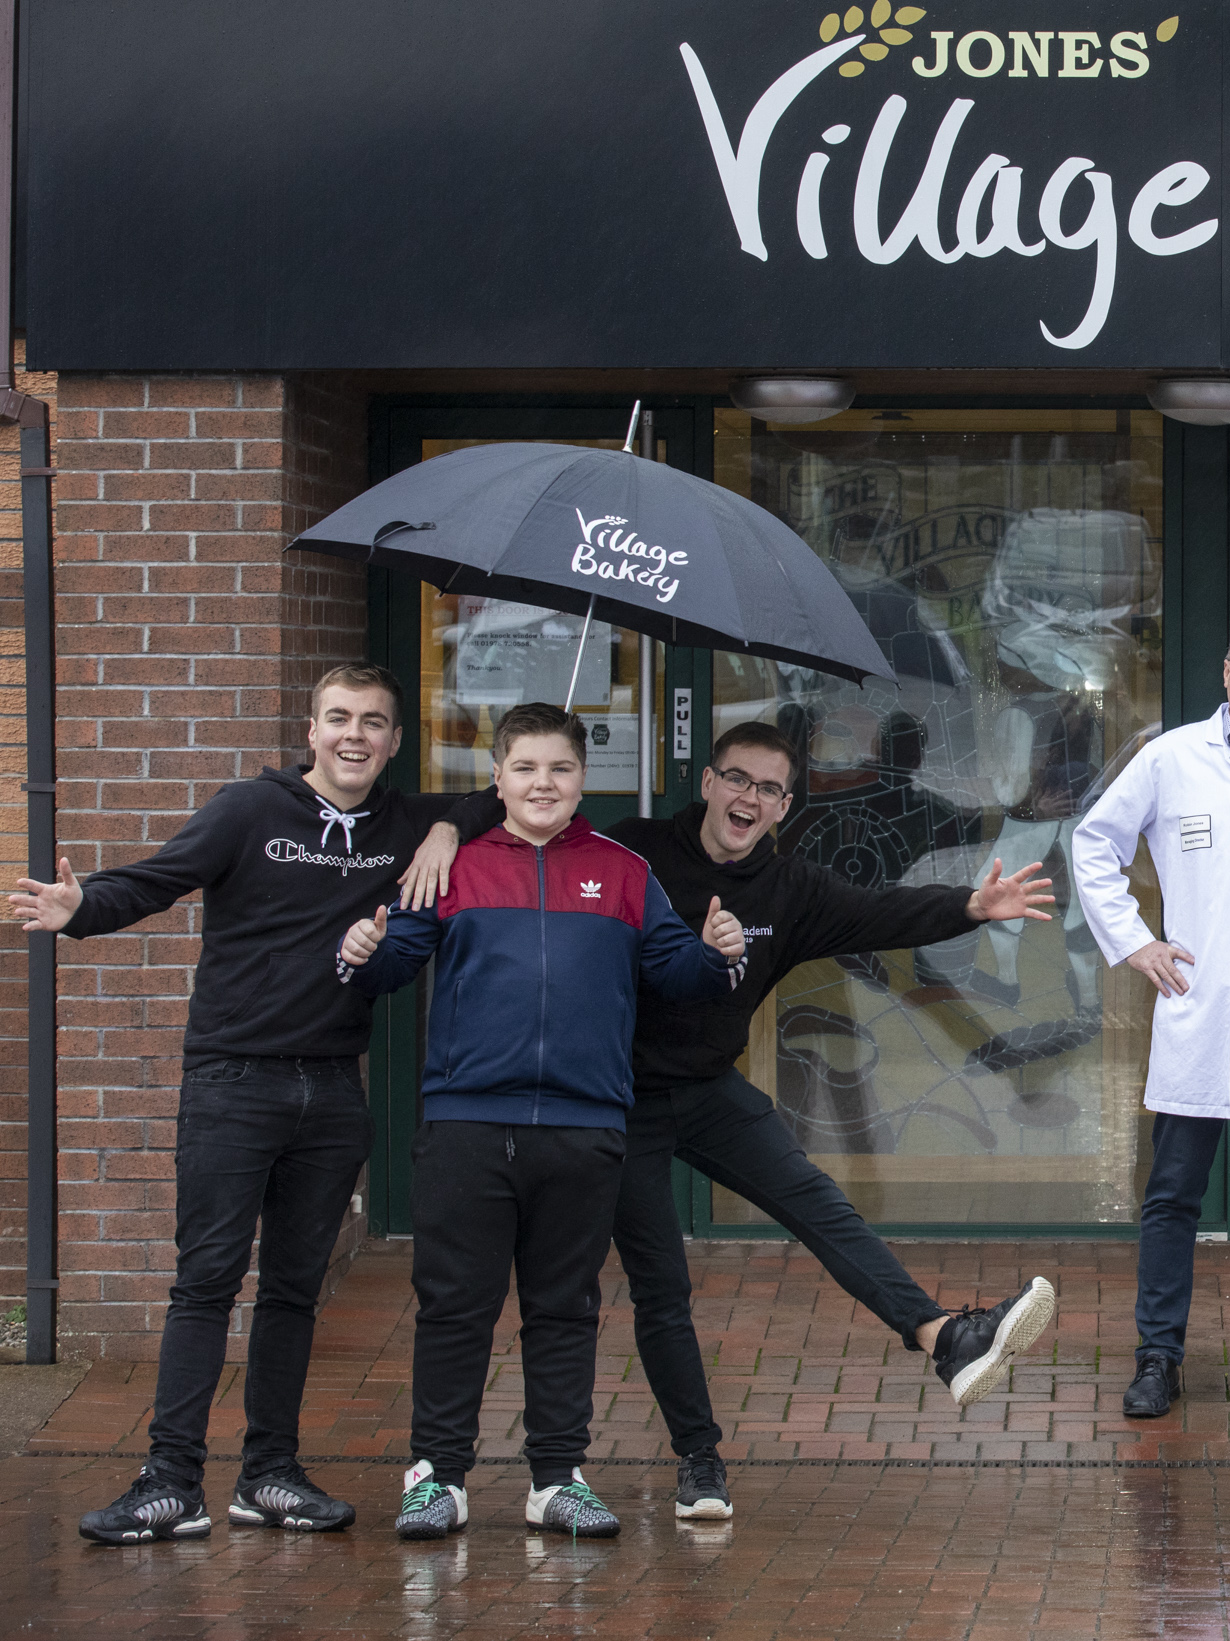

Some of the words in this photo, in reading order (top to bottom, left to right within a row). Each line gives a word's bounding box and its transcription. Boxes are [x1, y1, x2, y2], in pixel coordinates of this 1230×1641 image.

[912, 31, 1150, 78] JONES
[679, 34, 1219, 349] Village
[576, 508, 689, 574] Village
[571, 544, 679, 603] Bakery
[467, 606, 494, 615] THIS
[499, 606, 529, 615] DOOR
[534, 606, 545, 615] IS
[677, 696, 689, 750] PULL
[265, 838, 395, 877] Champion
[743, 924, 773, 936] ademi
